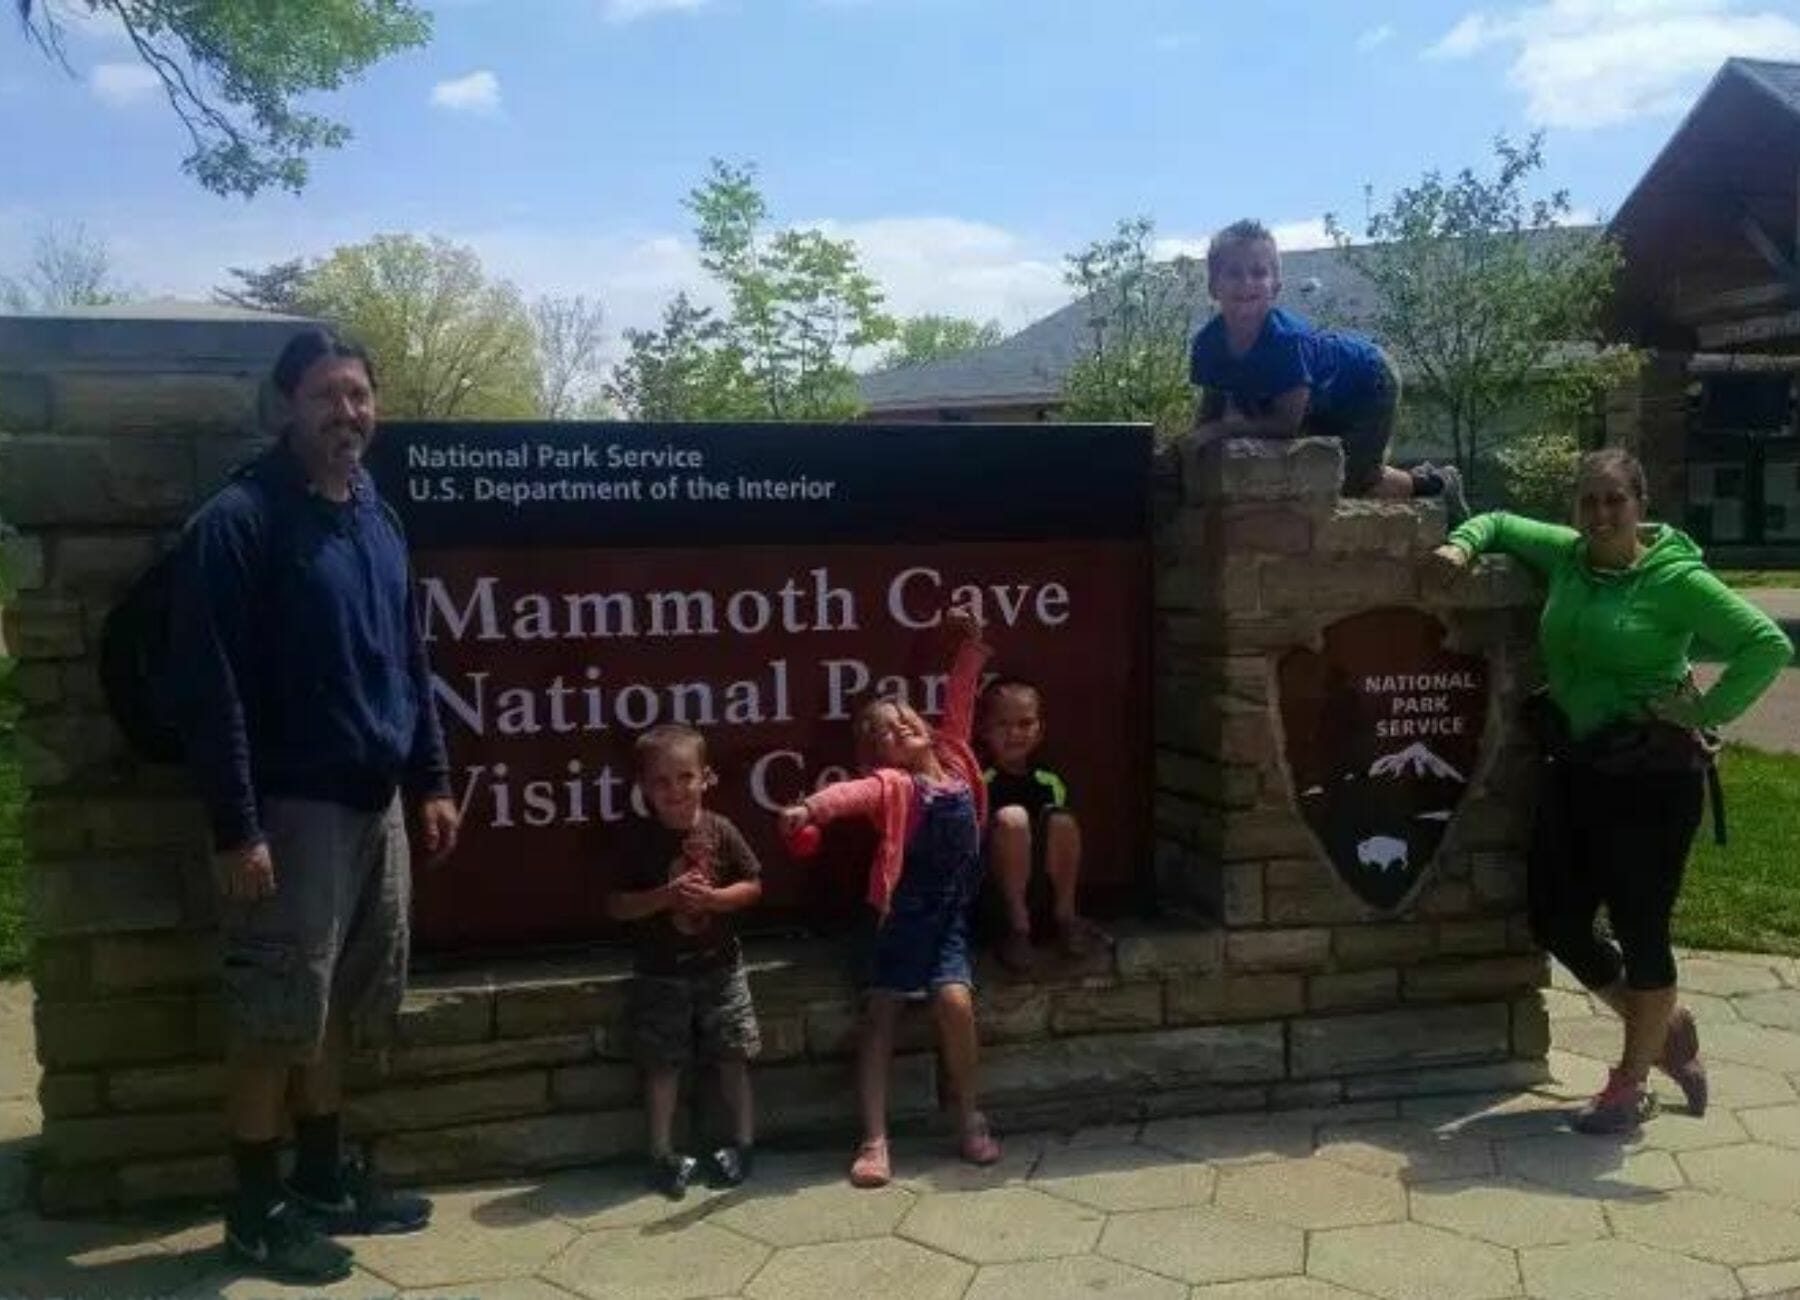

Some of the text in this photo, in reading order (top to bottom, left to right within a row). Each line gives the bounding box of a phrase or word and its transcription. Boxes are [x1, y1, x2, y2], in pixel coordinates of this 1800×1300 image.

[408, 444, 702, 468] National Park Service
[409, 475, 836, 505] U.S. Department of the Interior
[419, 567, 1070, 642] Mammoth Cave
[1365, 672, 1475, 693] NATIONAL
[428, 658, 1000, 737] National Par
[1392, 696, 1449, 713] PARK
[1376, 716, 1463, 737] SERVICE
